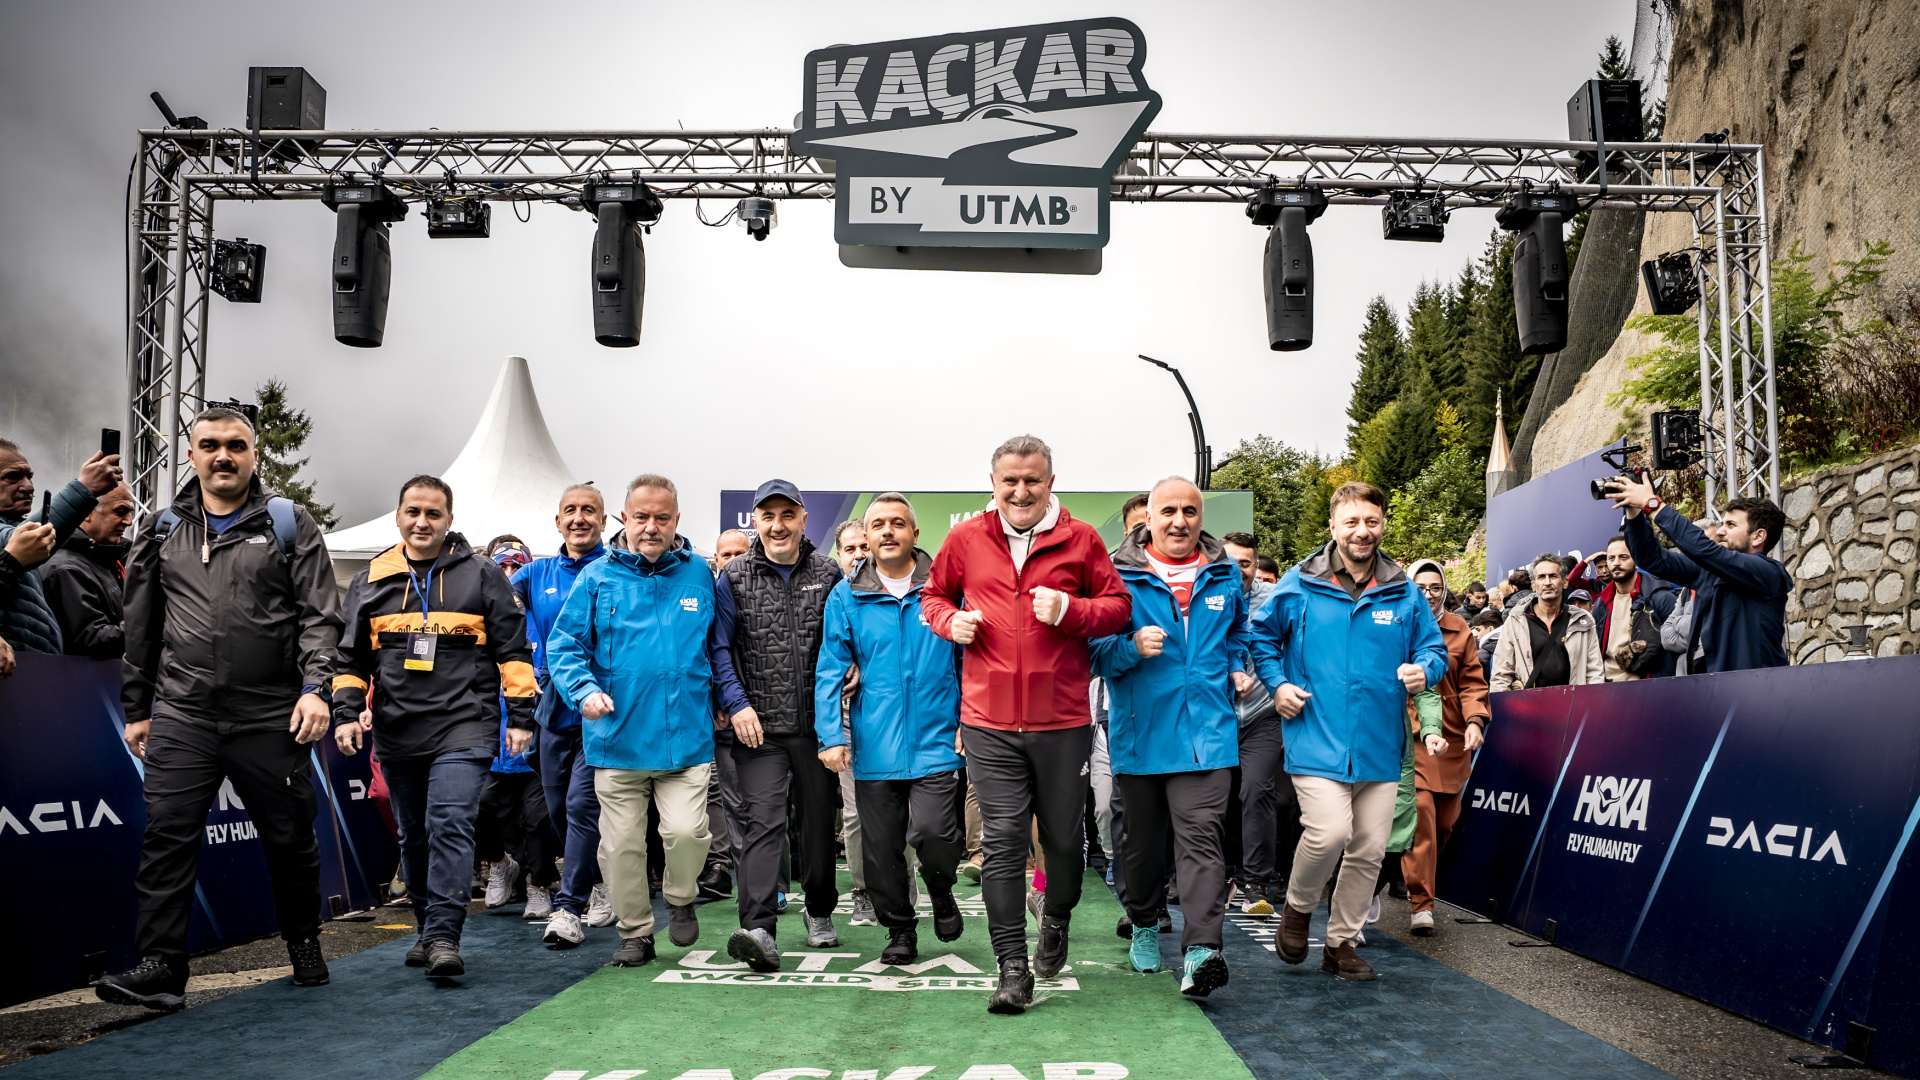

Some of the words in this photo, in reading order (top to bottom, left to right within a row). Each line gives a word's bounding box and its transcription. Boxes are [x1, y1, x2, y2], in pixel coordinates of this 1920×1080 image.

[870, 186, 912, 214] BY
[1471, 788, 1530, 816] DACIA
[1573, 775, 1651, 831] HOKA
[0, 798, 124, 835] ACIA
[206, 823, 228, 845] FLY
[229, 820, 260, 842] HUM
[1706, 816, 1847, 866] DACIA
[1566, 833, 1585, 853] FLY
[1582, 835, 1622, 861] HUMAN
[680, 972, 873, 984] WORLD
[897, 979, 1064, 989] SERIS
